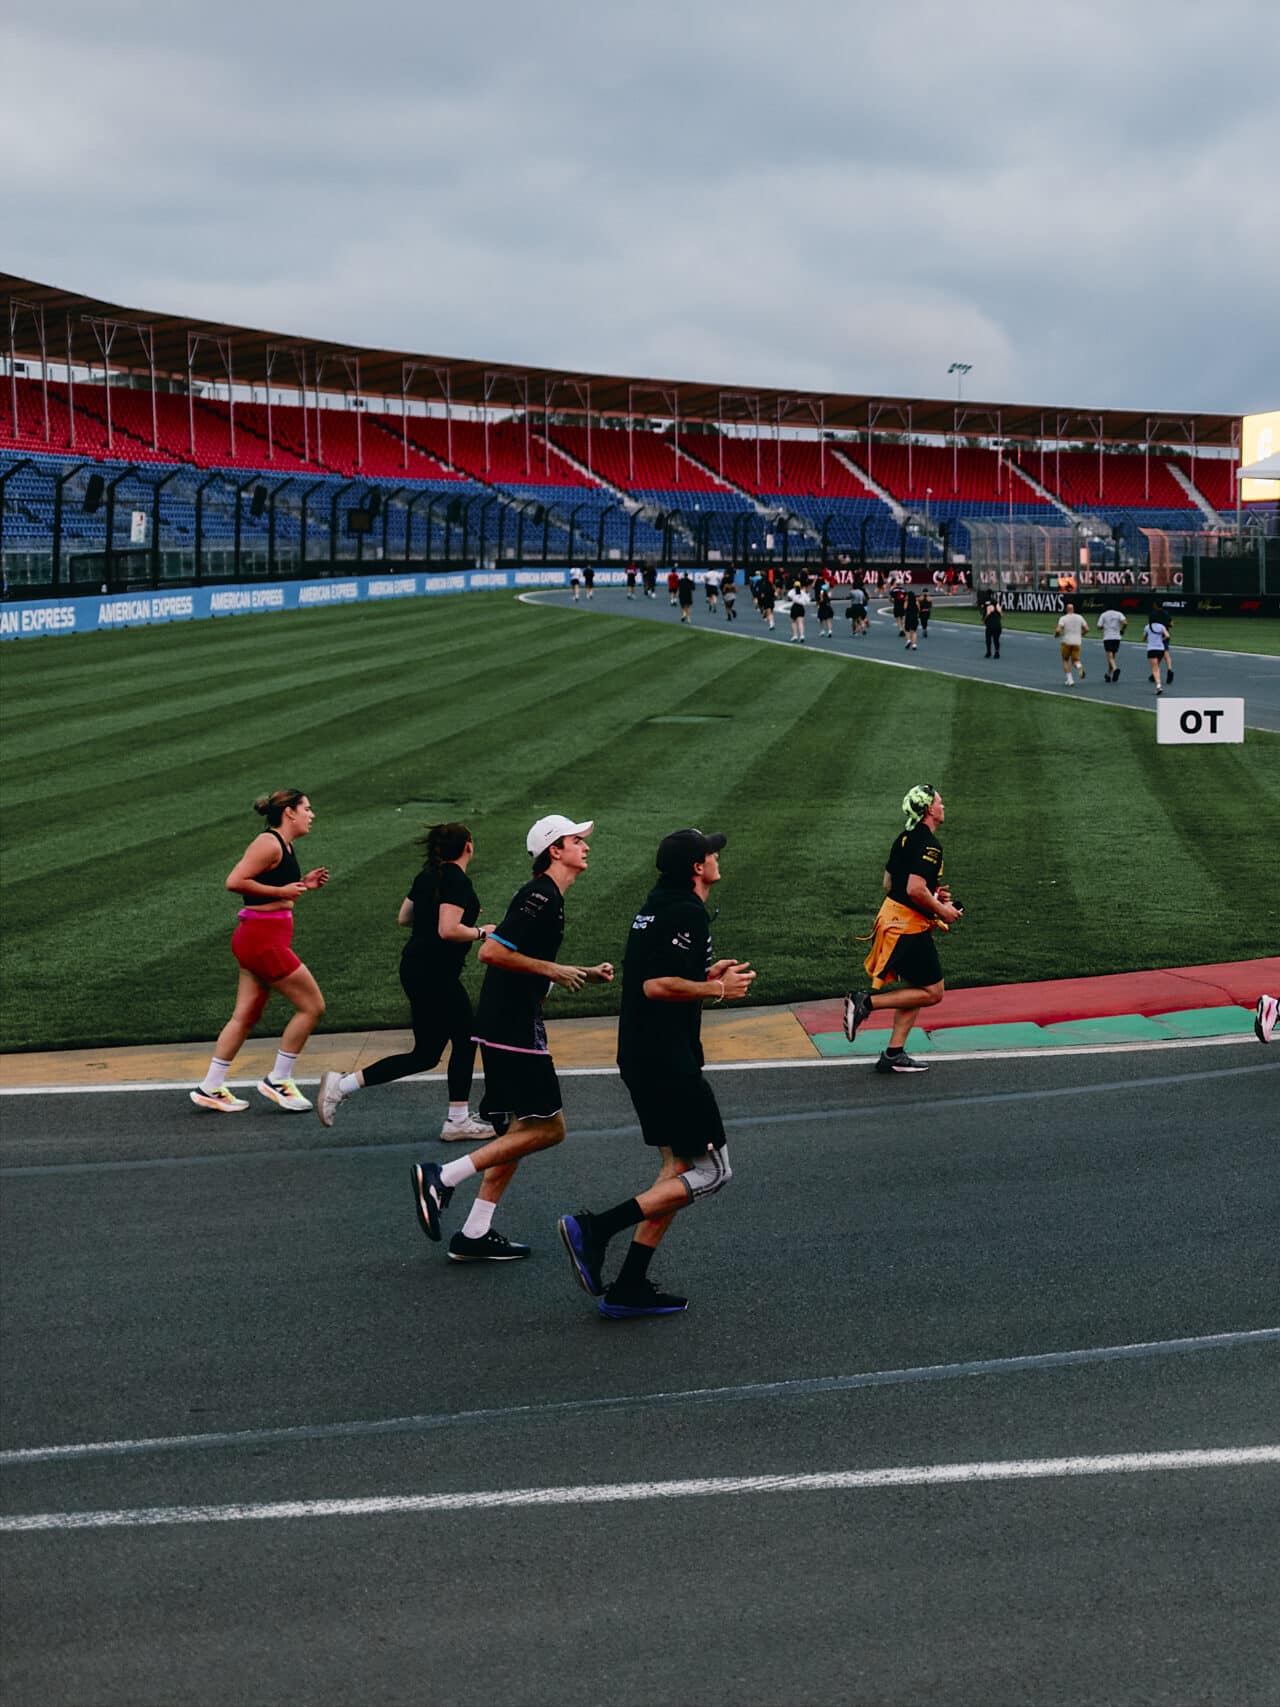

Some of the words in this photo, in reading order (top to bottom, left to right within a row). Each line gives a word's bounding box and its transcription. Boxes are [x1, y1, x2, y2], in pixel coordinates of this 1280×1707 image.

[210, 591, 250, 610] AMERICAN
[252, 588, 284, 607] EXPRESS
[298, 585, 330, 603] AMERICAN
[331, 582, 358, 599] EXPRESS
[1016, 593, 1064, 612] AIRWAYS
[0, 609, 19, 634] AN
[22, 606, 75, 632] EXPRESS
[98, 599, 149, 624] AMERICAN
[152, 596, 193, 617] EXPRESS
[1180, 710, 1224, 734] OT
